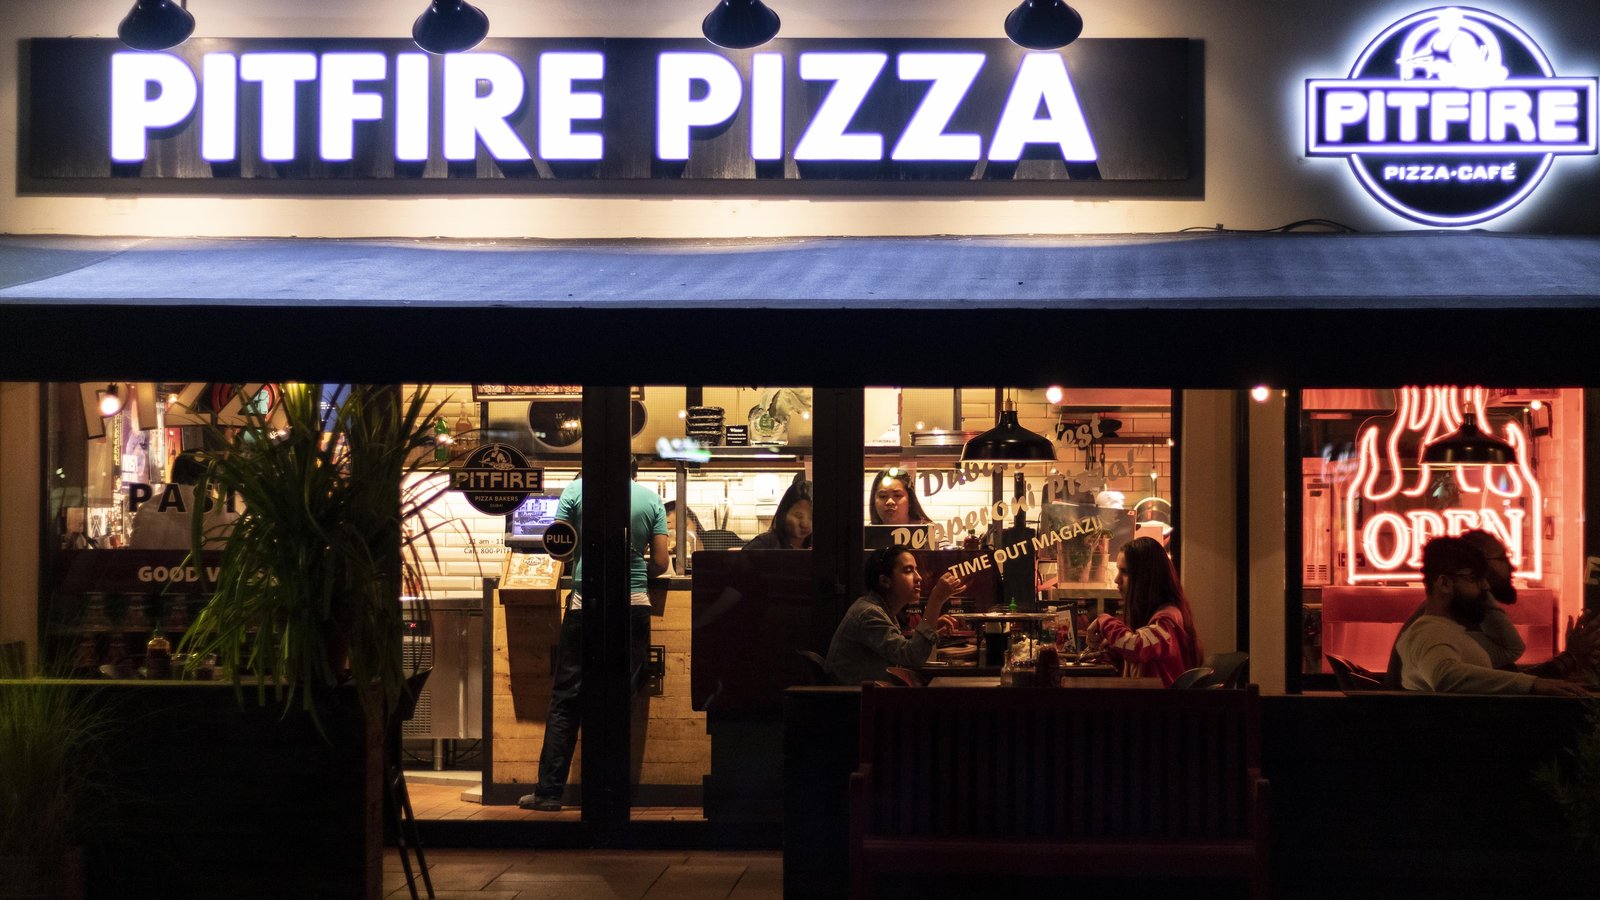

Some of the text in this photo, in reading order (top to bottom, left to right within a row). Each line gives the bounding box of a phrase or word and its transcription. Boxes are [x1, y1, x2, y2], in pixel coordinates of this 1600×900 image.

[110, 52, 1098, 162] PITFIRE PIZZA
[1324, 90, 1579, 142] PITFIRE
[455, 471, 539, 489] PITFIRE
[890, 482, 1036, 551] Pepperoni
[546, 534, 573, 544] PULL
[138, 565, 200, 583] GOOD
[948, 554, 992, 579] TIME
[993, 540, 1028, 564] OUT
